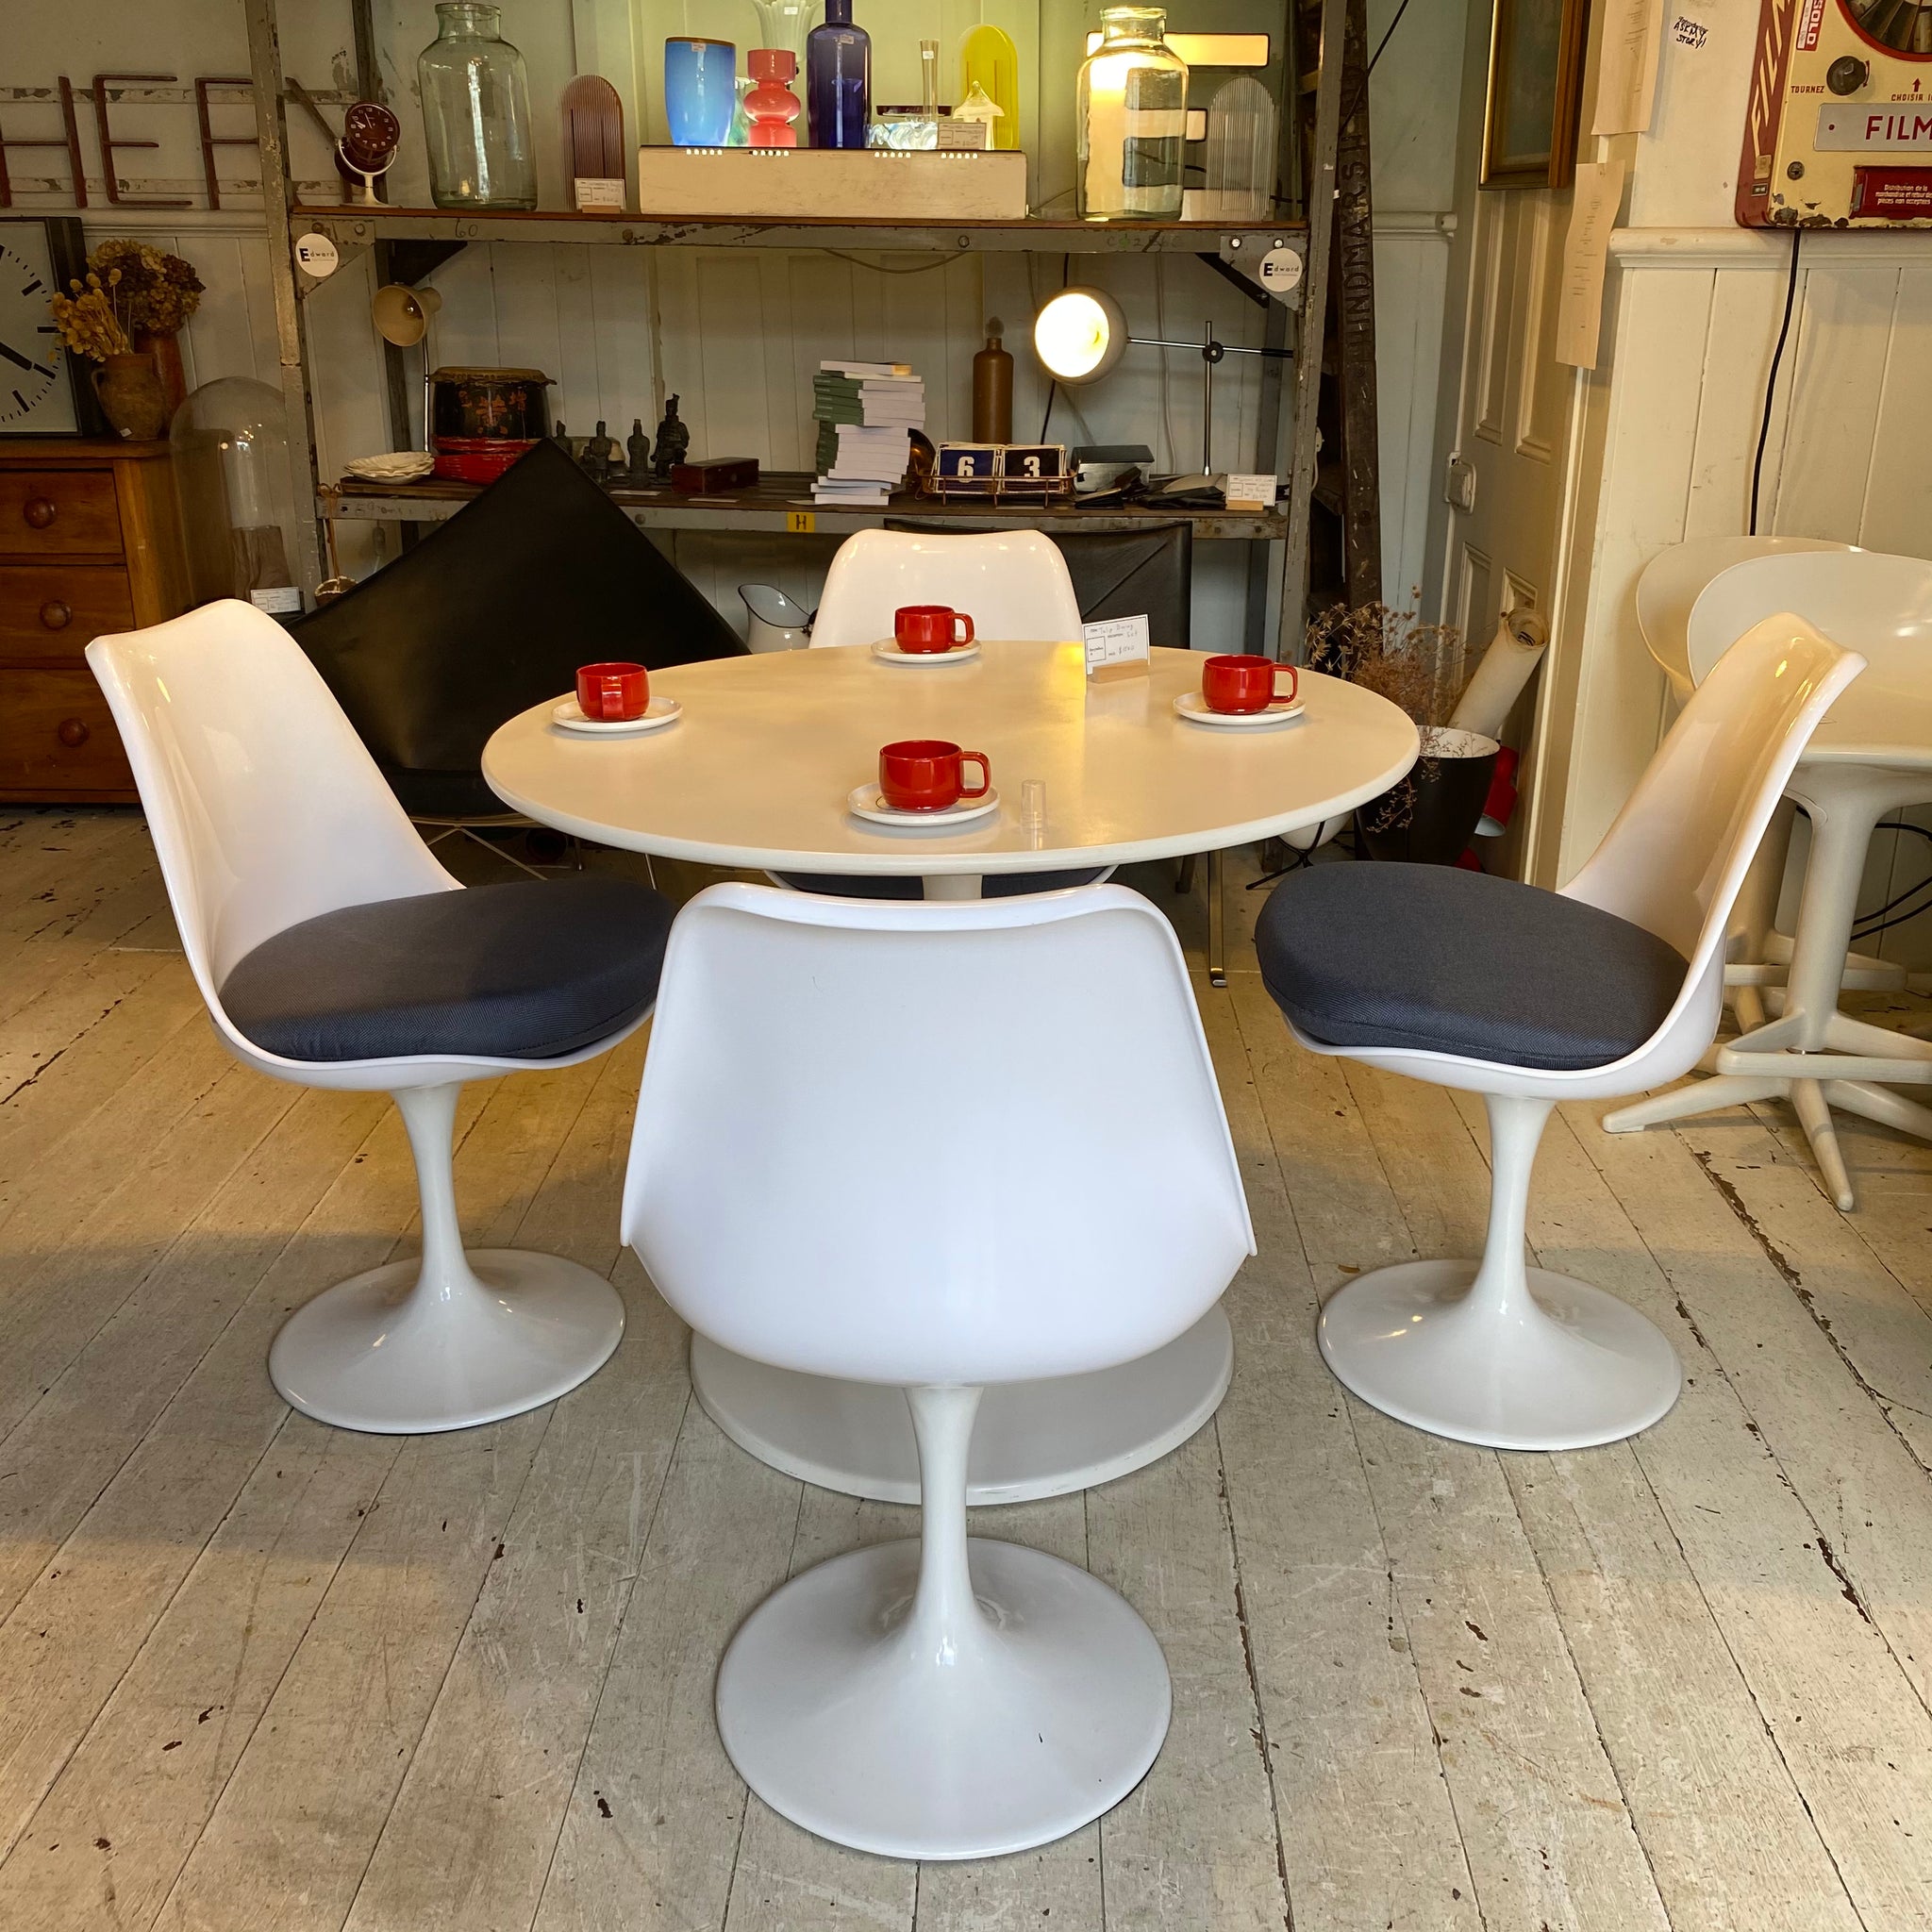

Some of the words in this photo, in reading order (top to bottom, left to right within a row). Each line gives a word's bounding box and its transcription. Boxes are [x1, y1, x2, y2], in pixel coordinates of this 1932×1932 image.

[1891, 93, 1924, 102] CHOISIR
[299, 248, 335, 261] Edward
[1263, 262, 1300, 276] Edward
[957, 456, 974, 483] 6
[1024, 456, 1041, 483] 3
[795, 514, 807, 529] H
